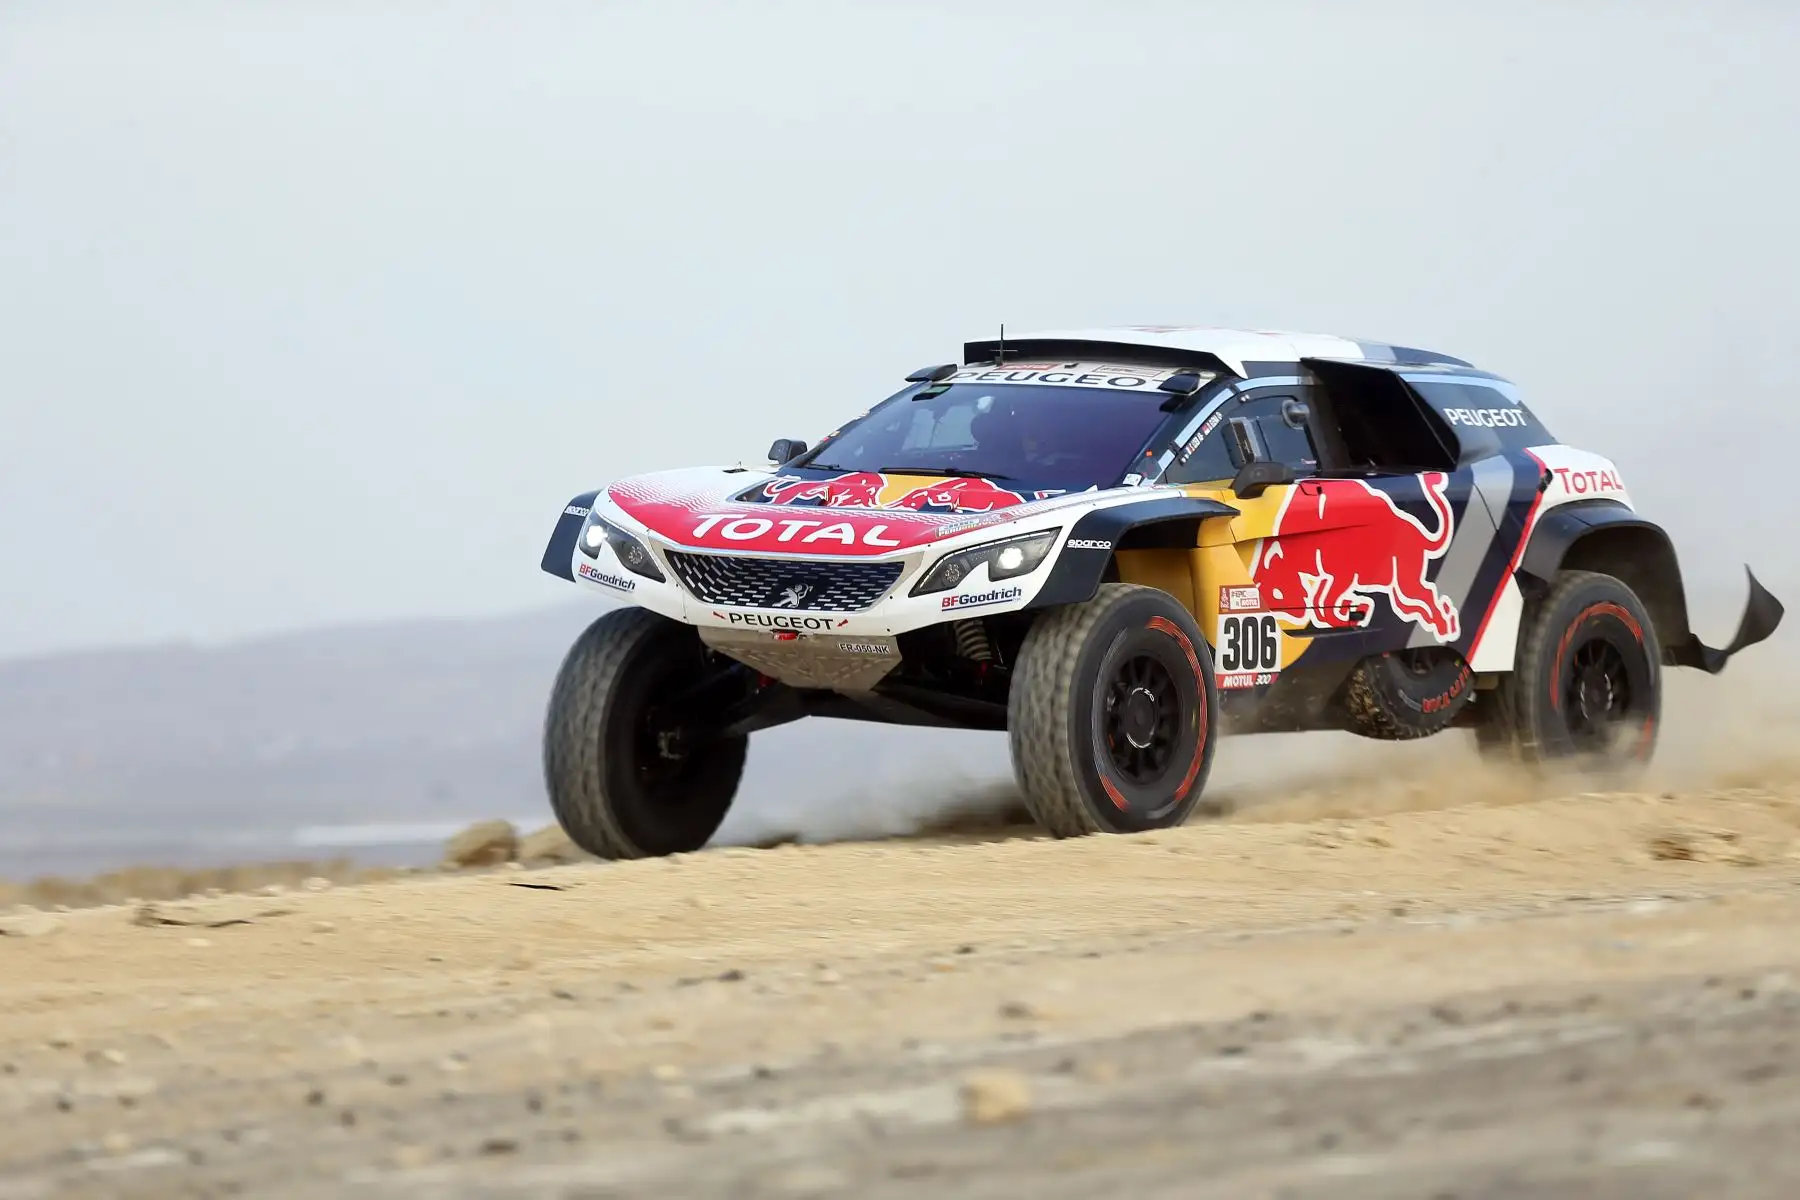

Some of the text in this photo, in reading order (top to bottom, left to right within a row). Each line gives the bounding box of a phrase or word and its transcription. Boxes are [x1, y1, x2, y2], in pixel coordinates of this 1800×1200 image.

[947, 371, 1164, 388] PEUGEO
[1443, 408, 1527, 428] PEUGEOT
[1554, 467, 1625, 495] TOTAL
[692, 513, 901, 547] TOTAL
[1067, 539, 1112, 550] sparco
[579, 563, 636, 591] BFGoodrich
[942, 586, 1022, 608] BFGoodrich
[728, 612, 834, 631] PEUGEOT
[1222, 616, 1277, 671] 306
[1223, 675, 1254, 688] MOTUL
